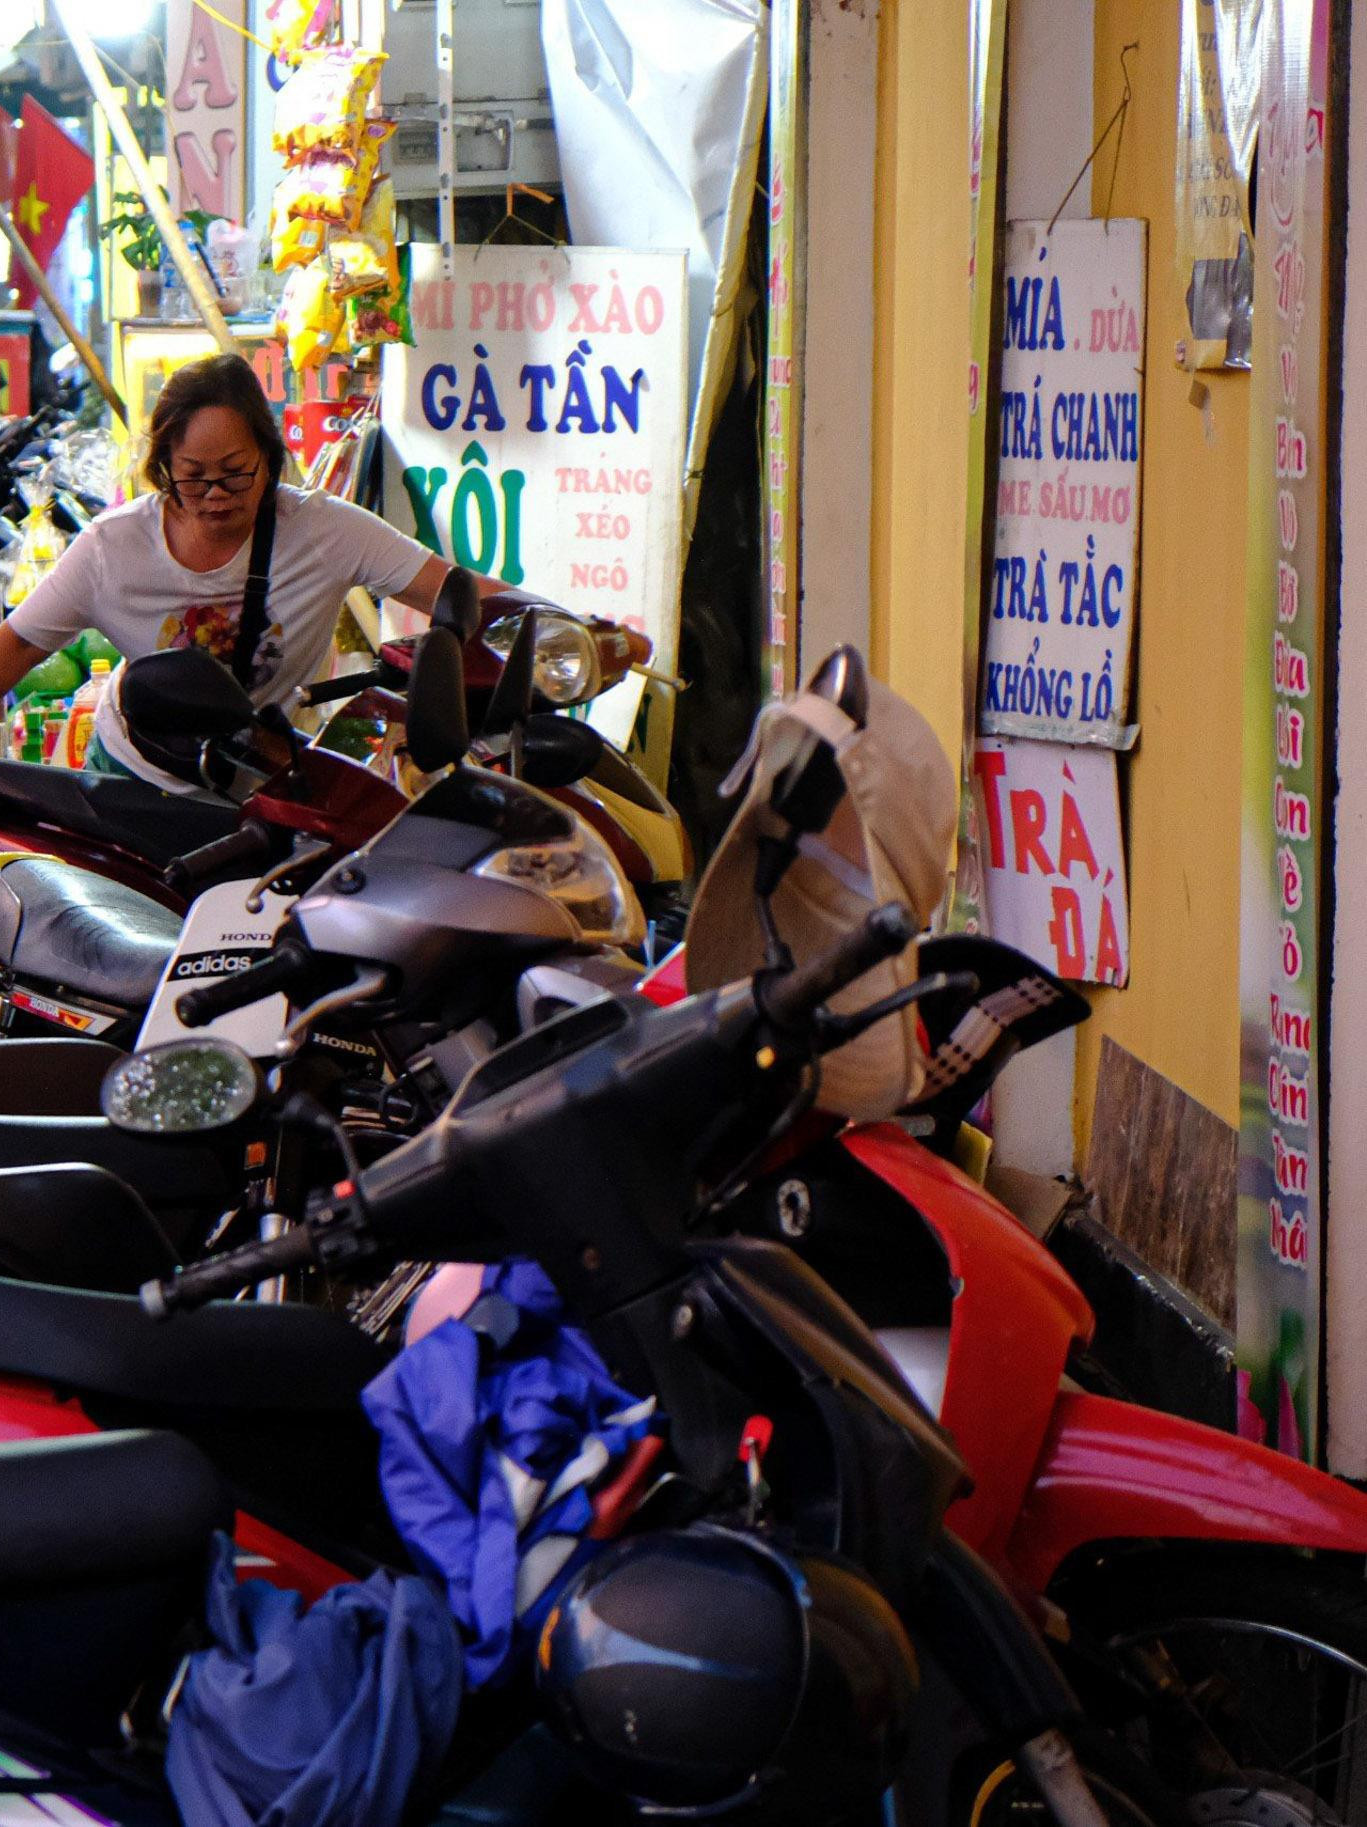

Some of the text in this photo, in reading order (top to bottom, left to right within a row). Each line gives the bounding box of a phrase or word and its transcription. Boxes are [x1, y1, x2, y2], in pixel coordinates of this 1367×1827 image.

[469, 259, 555, 332] PHỞ
[568, 270, 664, 335] XÀO
[1003, 246, 1065, 350] MÍA
[422, 343, 505, 431] GÀ
[520, 339, 646, 433] TẦN
[1052, 392, 1138, 461] CHANH
[402, 440, 525, 586] XÔI
[1039, 466, 1084, 523] SẤU
[1089, 484, 1131, 524] MƠ
[570, 557, 629, 592] NGÔ
[993, 548, 1049, 622] TRÀ
[986, 636, 1113, 722] KHỔNG LỒ
[974, 752, 1100, 881] TRÀ
[220, 933, 272, 942] HOND
[1050, 868, 1124, 987] ĐÁ
[177, 955, 252, 976] adidas
[313, 1032, 377, 1057] HONDA
